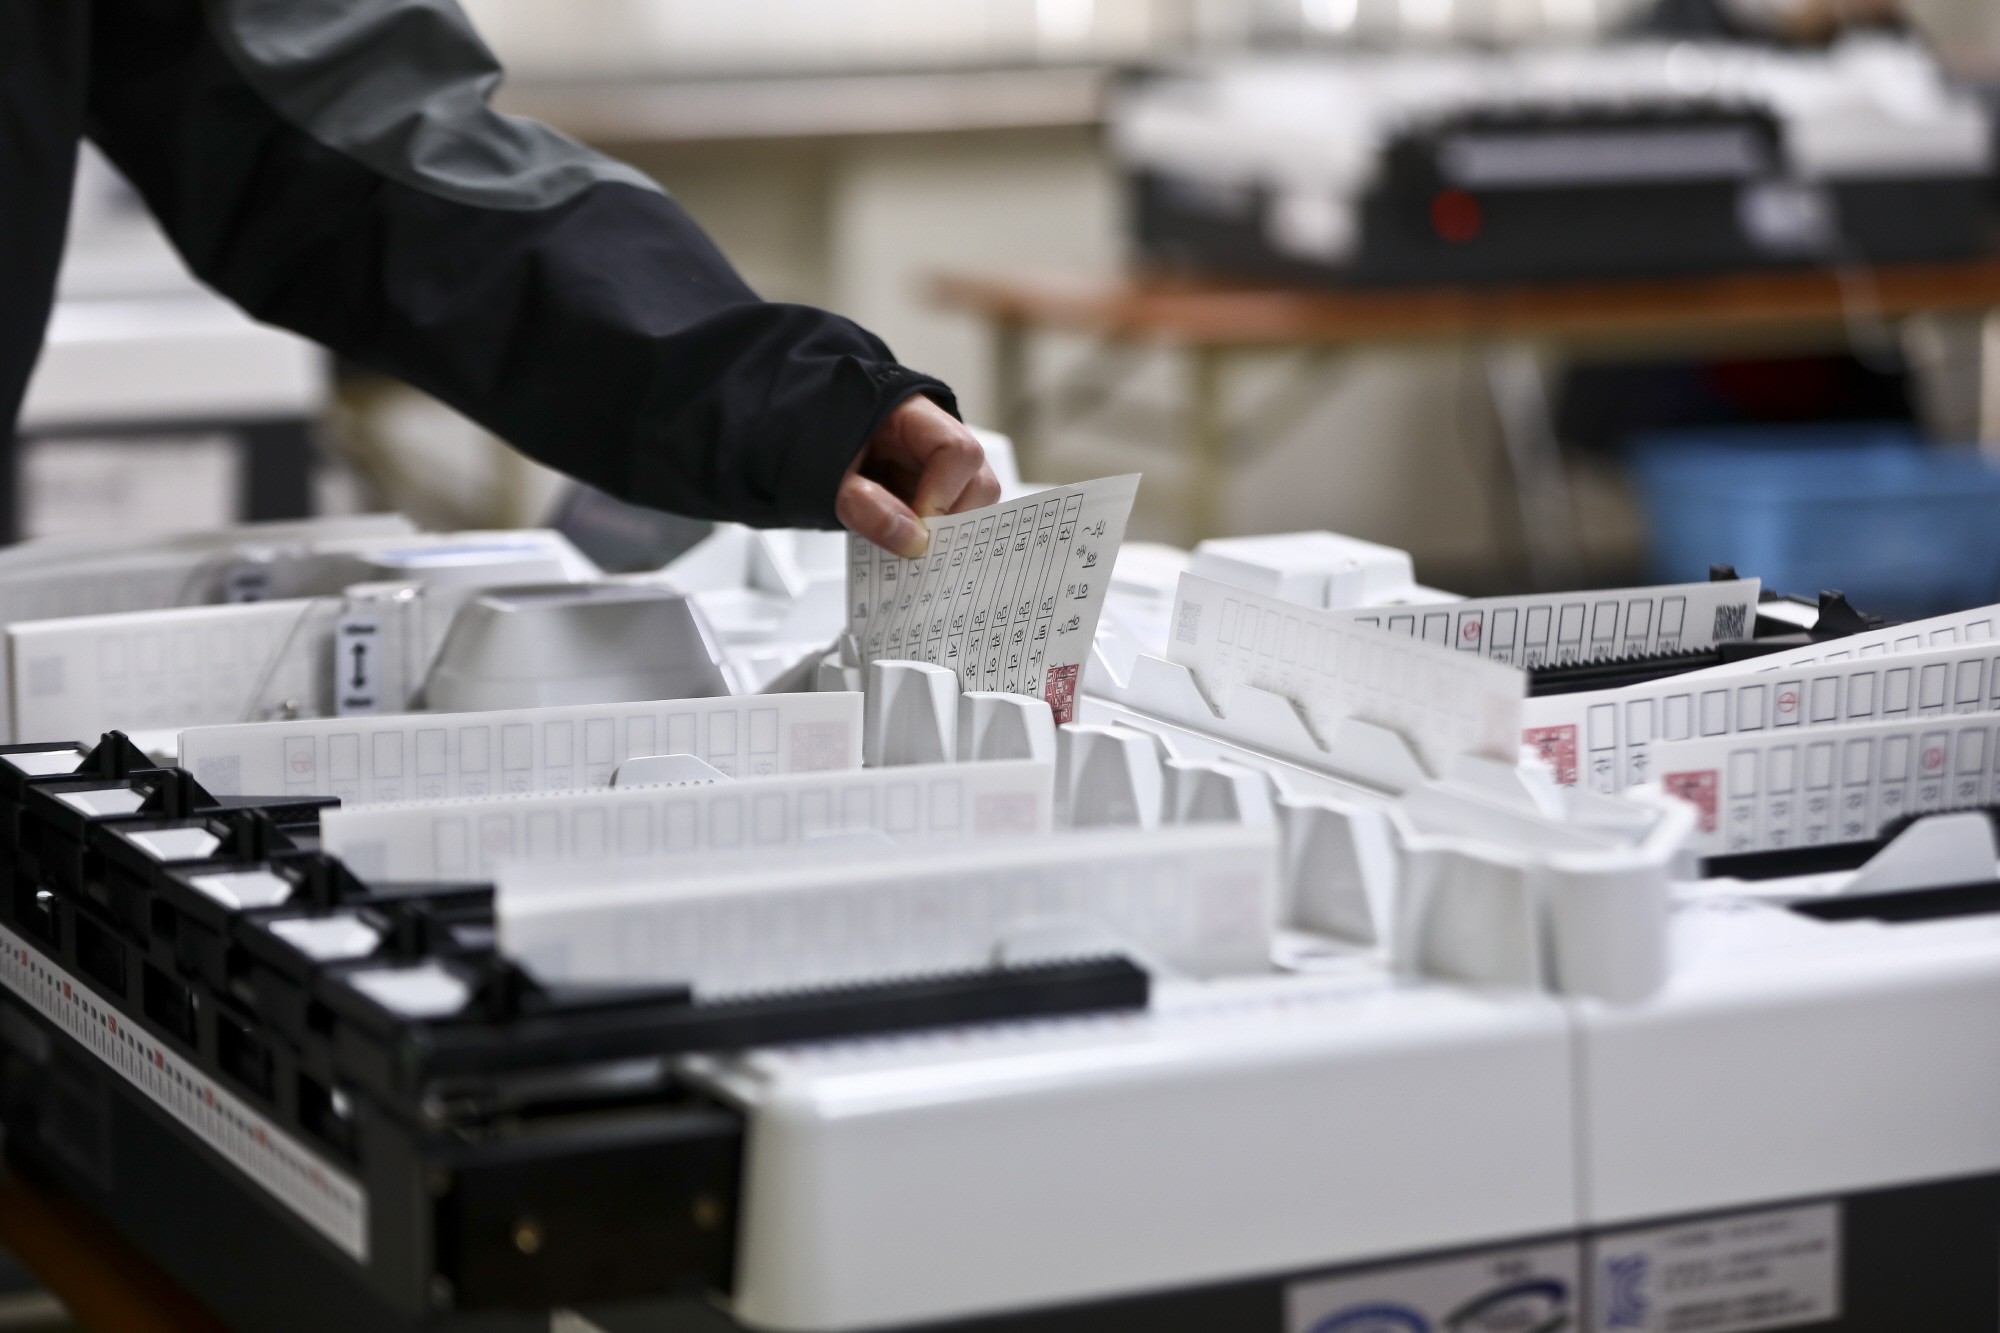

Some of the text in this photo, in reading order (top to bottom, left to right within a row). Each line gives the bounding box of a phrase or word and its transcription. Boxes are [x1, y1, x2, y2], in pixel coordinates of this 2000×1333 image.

[960, 532, 969, 540] 6
[965, 636, 979, 691] 도봉
[1026, 624, 1046, 694] 백두산
